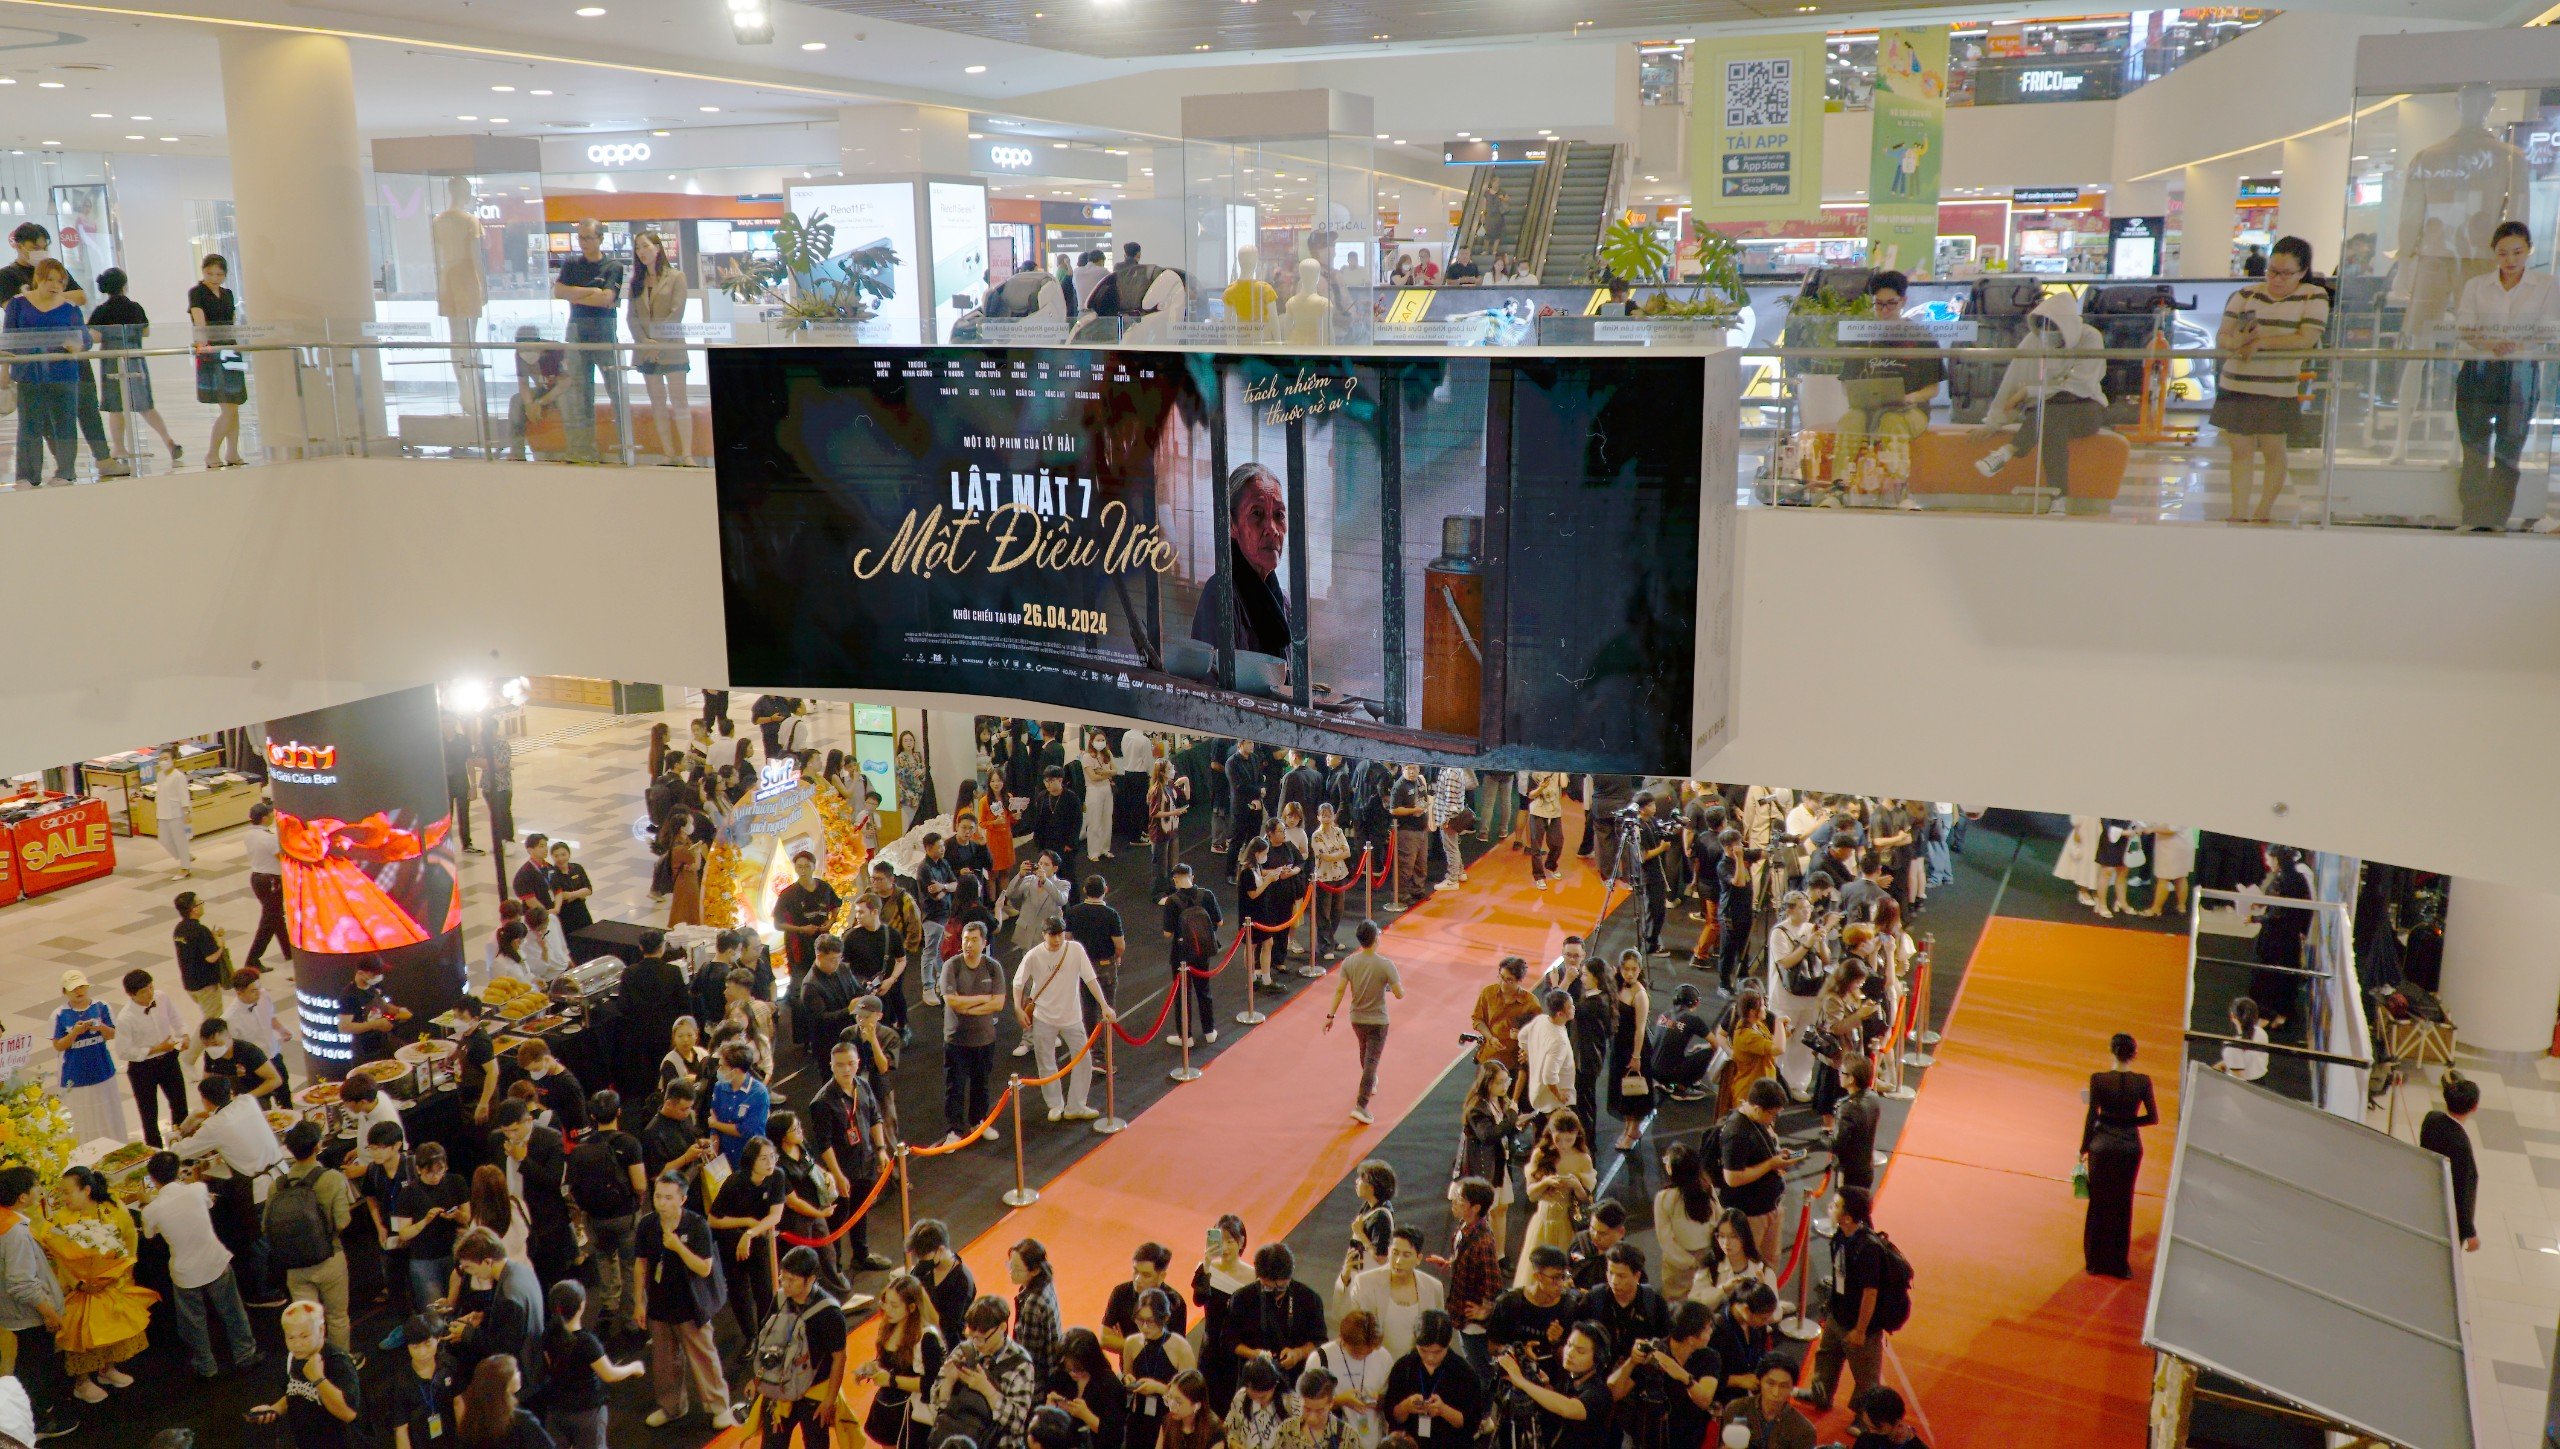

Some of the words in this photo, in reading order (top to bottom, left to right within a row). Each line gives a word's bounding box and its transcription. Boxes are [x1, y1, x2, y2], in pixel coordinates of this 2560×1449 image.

[1840, 44, 1850, 52] 20
[2021, 71, 2063, 92] FRICO
[1726, 131, 1751, 150] TẢI
[1755, 134, 1788, 149] APP
[587, 143, 651, 167] oppo
[991, 146, 1032, 169] oppo
[1743, 162, 1761, 171] App
[1762, 160, 1785, 170] Store
[1742, 184, 1770, 193] Google
[1770, 183, 1787, 193] Play
[1319, 221, 1366, 231] OPTICAL
[60, 234, 79, 242] SALE
[1242, 373, 1279, 405] trách
[1284, 367, 1333, 395] nhiệm
[964, 434, 982, 450] MỘT
[986, 434, 996, 450] BỘ
[1000, 438, 1021, 450] PHIM
[1024, 436, 1040, 450] CỦA
[1042, 432, 1053, 451] LÝ
[1058, 433, 1075, 452] HẢI
[951, 464, 1001, 518] LẬT
[1012, 467, 1069, 522] MẶT
[1078, 478, 1092, 518] 7
[853, 503, 980, 580] Một
[986, 502, 1099, 574] Điều
[1100, 500, 1179, 575] Ước
[952, 608, 971, 621] KHỞI
[972, 608, 993, 622] CHIẾU
[994, 612, 1007, 625] TẠI
[1008, 613, 1022, 626] RẠP
[1023, 602, 1108, 635] 26.04.2024
[292, 773, 312, 784] Của
[314, 774, 337, 785] Bạn
[762, 758, 794, 787] Surf
[22, 824, 107, 871] SALE
[311, 996, 332, 1009] VÀO
[323, 1049, 353, 1060] 10/04
